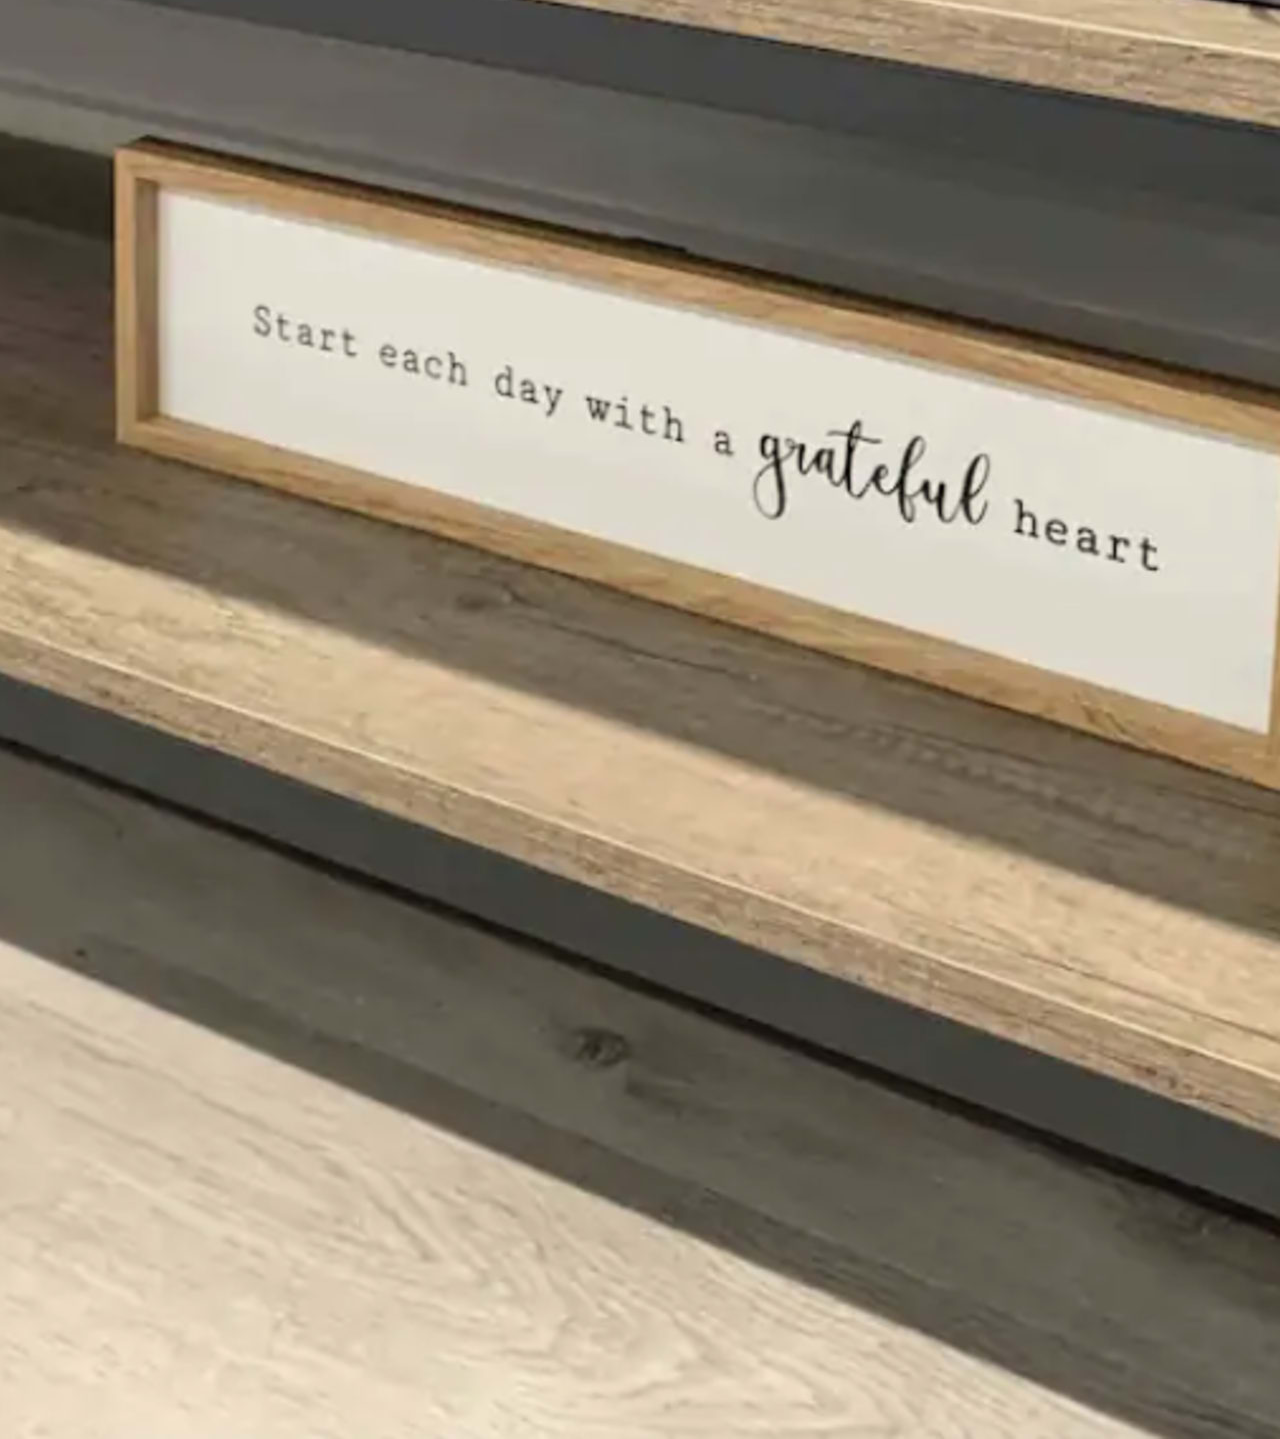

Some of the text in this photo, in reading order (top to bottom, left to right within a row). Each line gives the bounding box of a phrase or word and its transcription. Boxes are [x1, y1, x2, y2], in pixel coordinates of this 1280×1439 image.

[252, 304, 1161, 572] Start each day with a grateful heart
